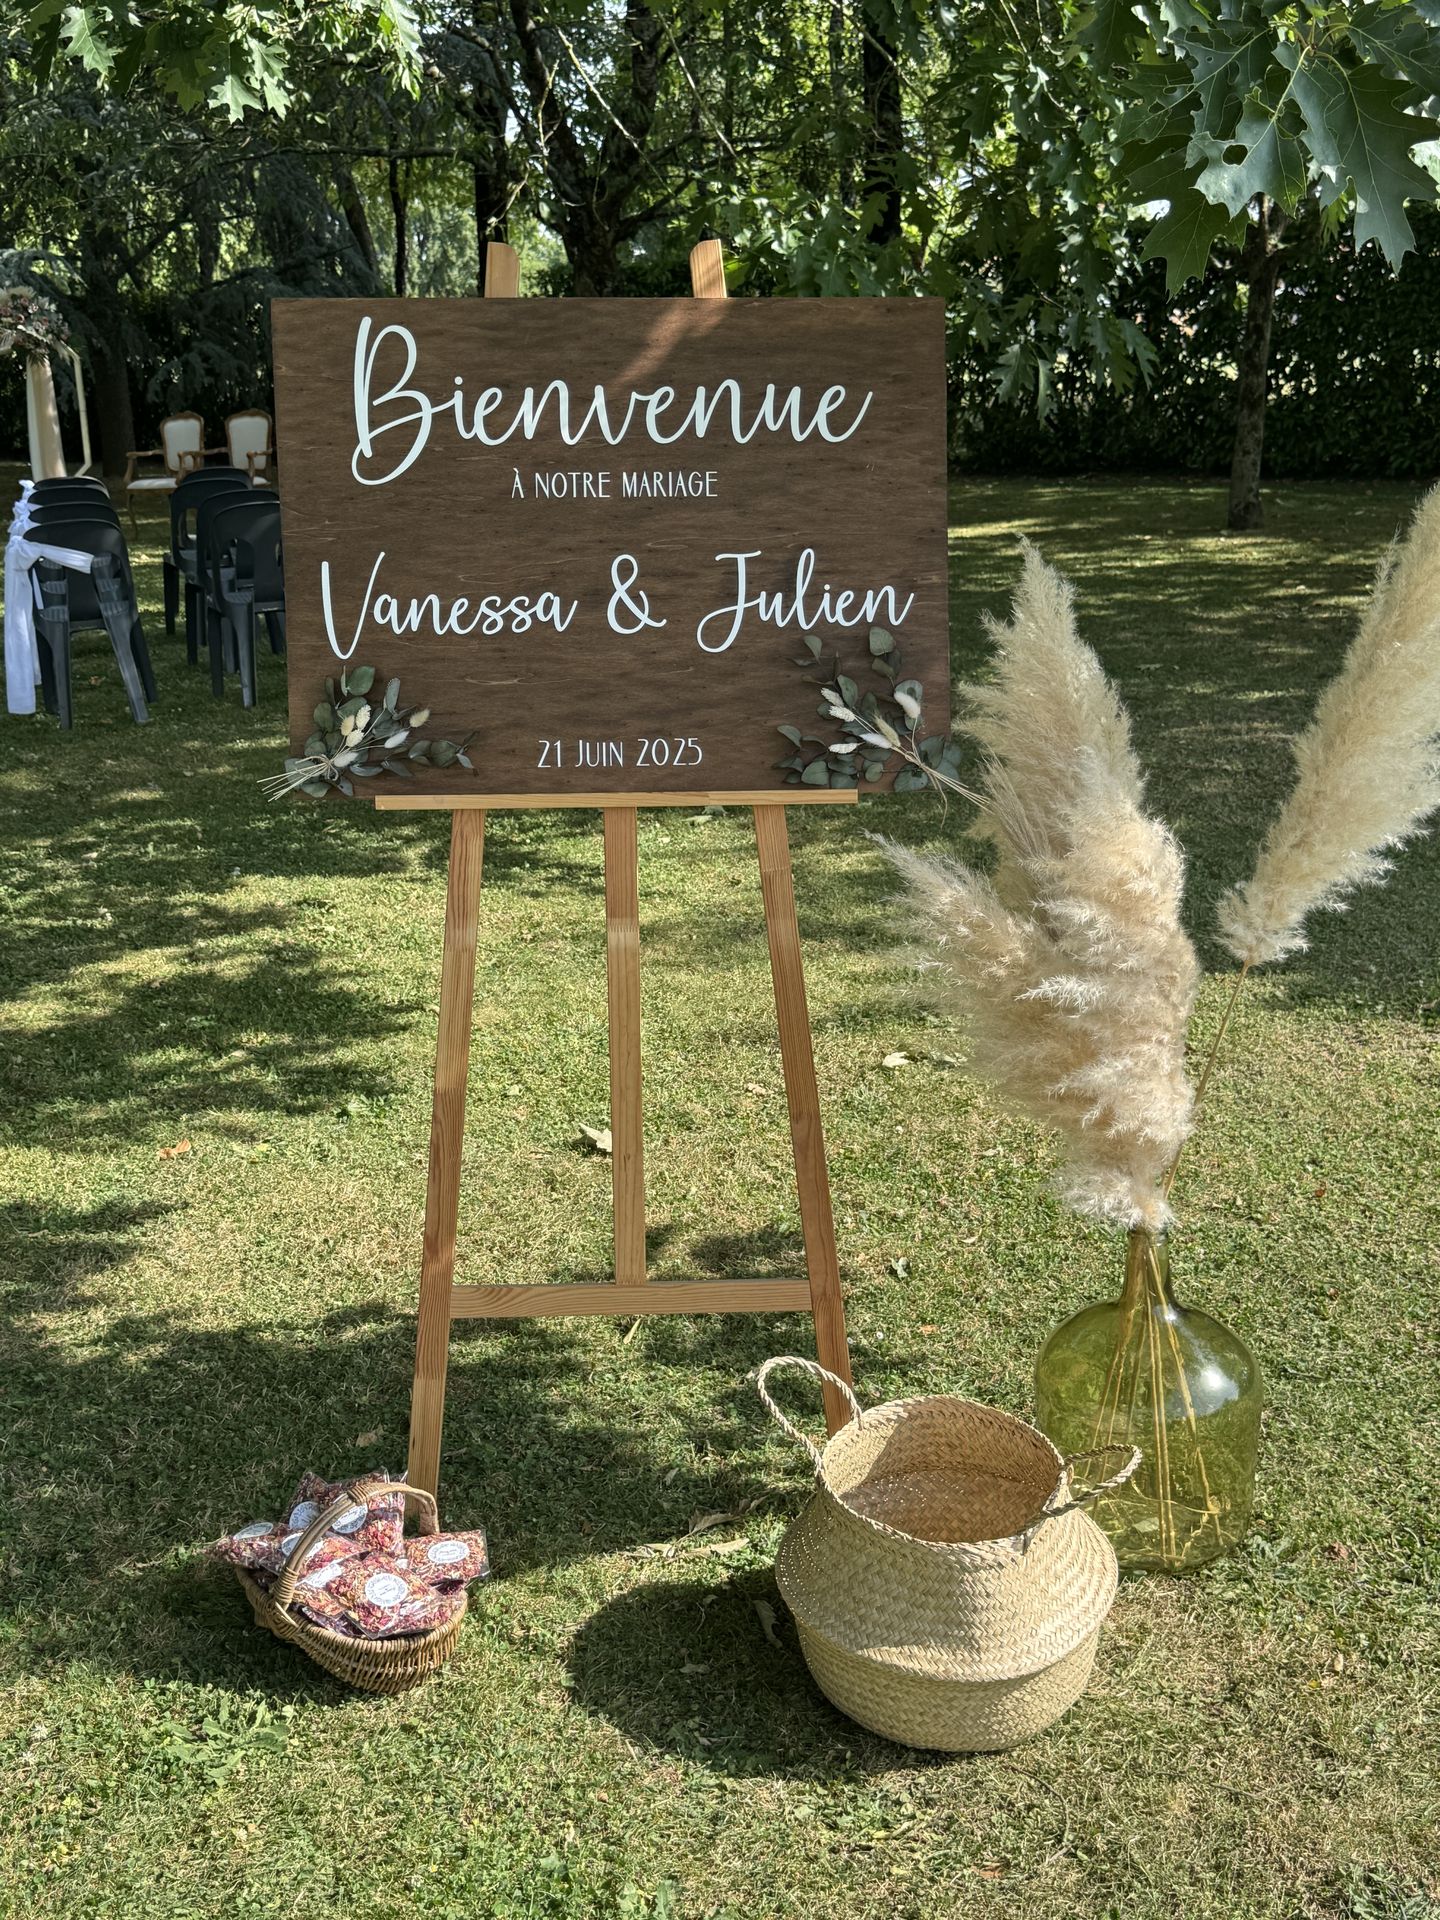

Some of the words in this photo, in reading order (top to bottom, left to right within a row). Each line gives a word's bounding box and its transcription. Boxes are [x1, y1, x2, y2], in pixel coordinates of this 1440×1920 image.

[352, 316, 872, 485] Bienvenue
[511, 467, 525, 499] À
[535, 471, 611, 499] NOTRE
[622, 470, 718, 498] MARIAGE
[321, 551, 578, 660] Vanessa
[606, 553, 667, 635] &
[696, 548, 915, 653] Julien
[537, 739, 562, 768] 21
[575, 739, 624, 768] JUIN
[636, 737, 703, 767] 2025
